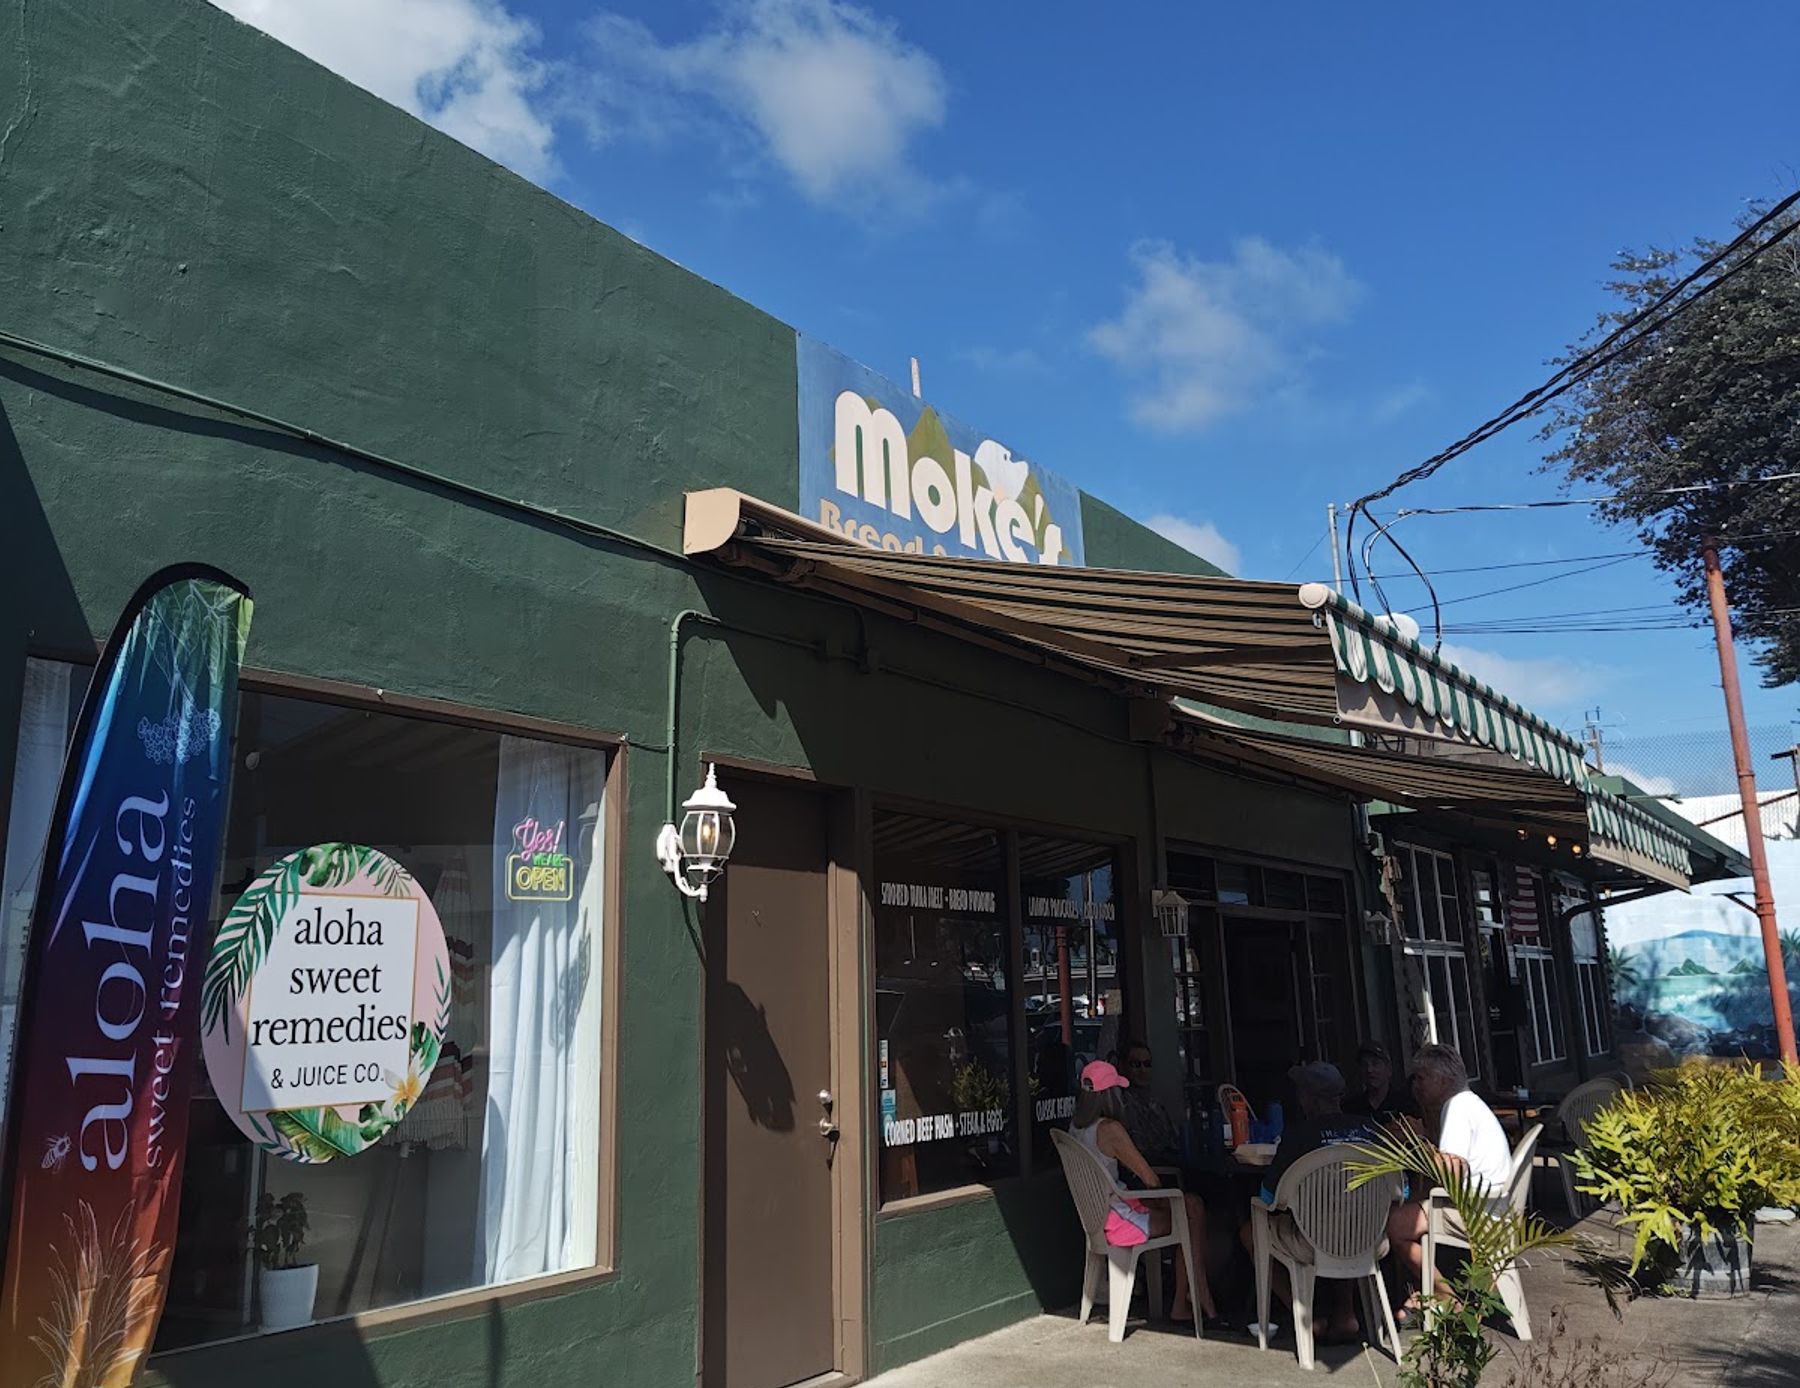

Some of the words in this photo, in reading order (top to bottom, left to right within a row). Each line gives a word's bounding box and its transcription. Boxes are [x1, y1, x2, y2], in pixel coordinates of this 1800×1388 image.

[515, 818, 564, 861] Yes!
[516, 866, 566, 891] OPEN
[159, 797, 196, 1011] remedies
[294, 907, 384, 945] aloha
[65, 788, 171, 1171] aloha
[290, 964, 382, 994] sweet
[251, 1004, 407, 1046] remedies
[270, 1068, 284, 1089] &
[290, 1065, 347, 1087] JUICE
[354, 1062, 385, 1083] CO.
[146, 1029, 175, 1169] sweet
[884, 1119, 916, 1147] CORNED
[916, 1116, 934, 1143] BEEF
[934, 1113, 955, 1140] HASH
